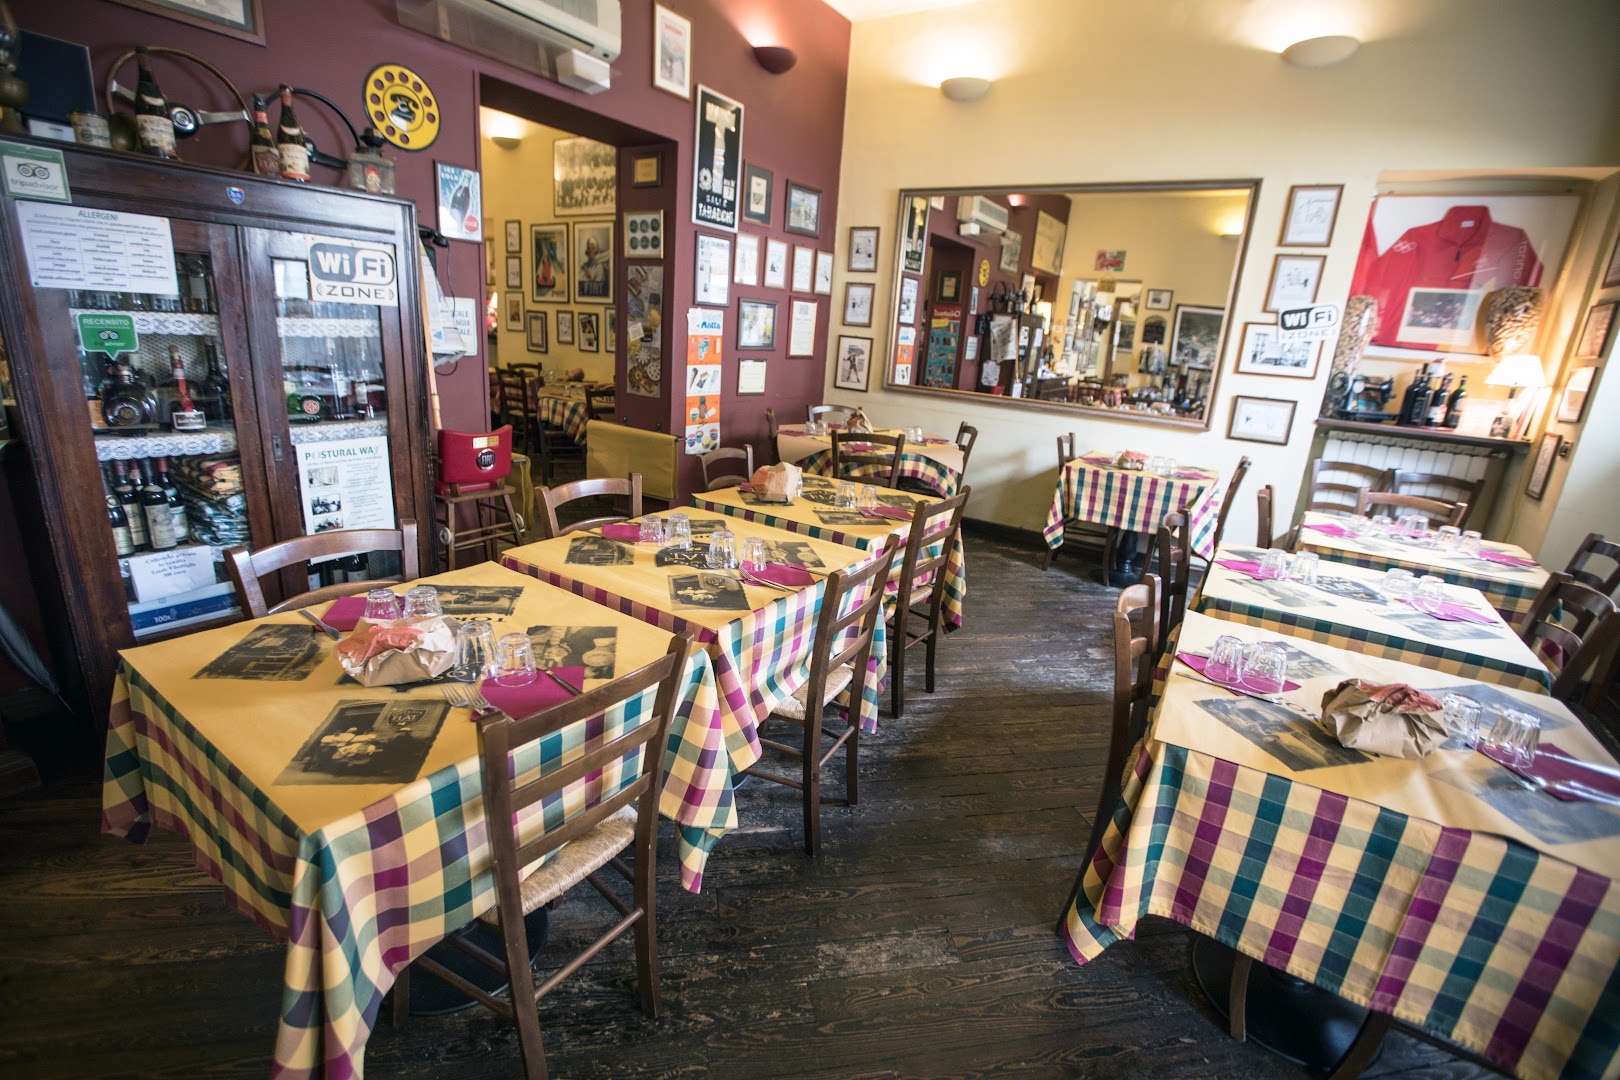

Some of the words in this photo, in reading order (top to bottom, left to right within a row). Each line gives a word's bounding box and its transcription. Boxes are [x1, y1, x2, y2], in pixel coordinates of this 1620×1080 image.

[11, 178, 59, 191] tripadvisor
[78, 210, 119, 221] ALLERGENI
[698, 203, 734, 224] TABACCHI
[326, 285, 385, 299] ZONE
[82, 318, 130, 326] RECENSITO
[1288, 328, 1329, 339] ZONE
[154, 615, 171, 623] 100x
